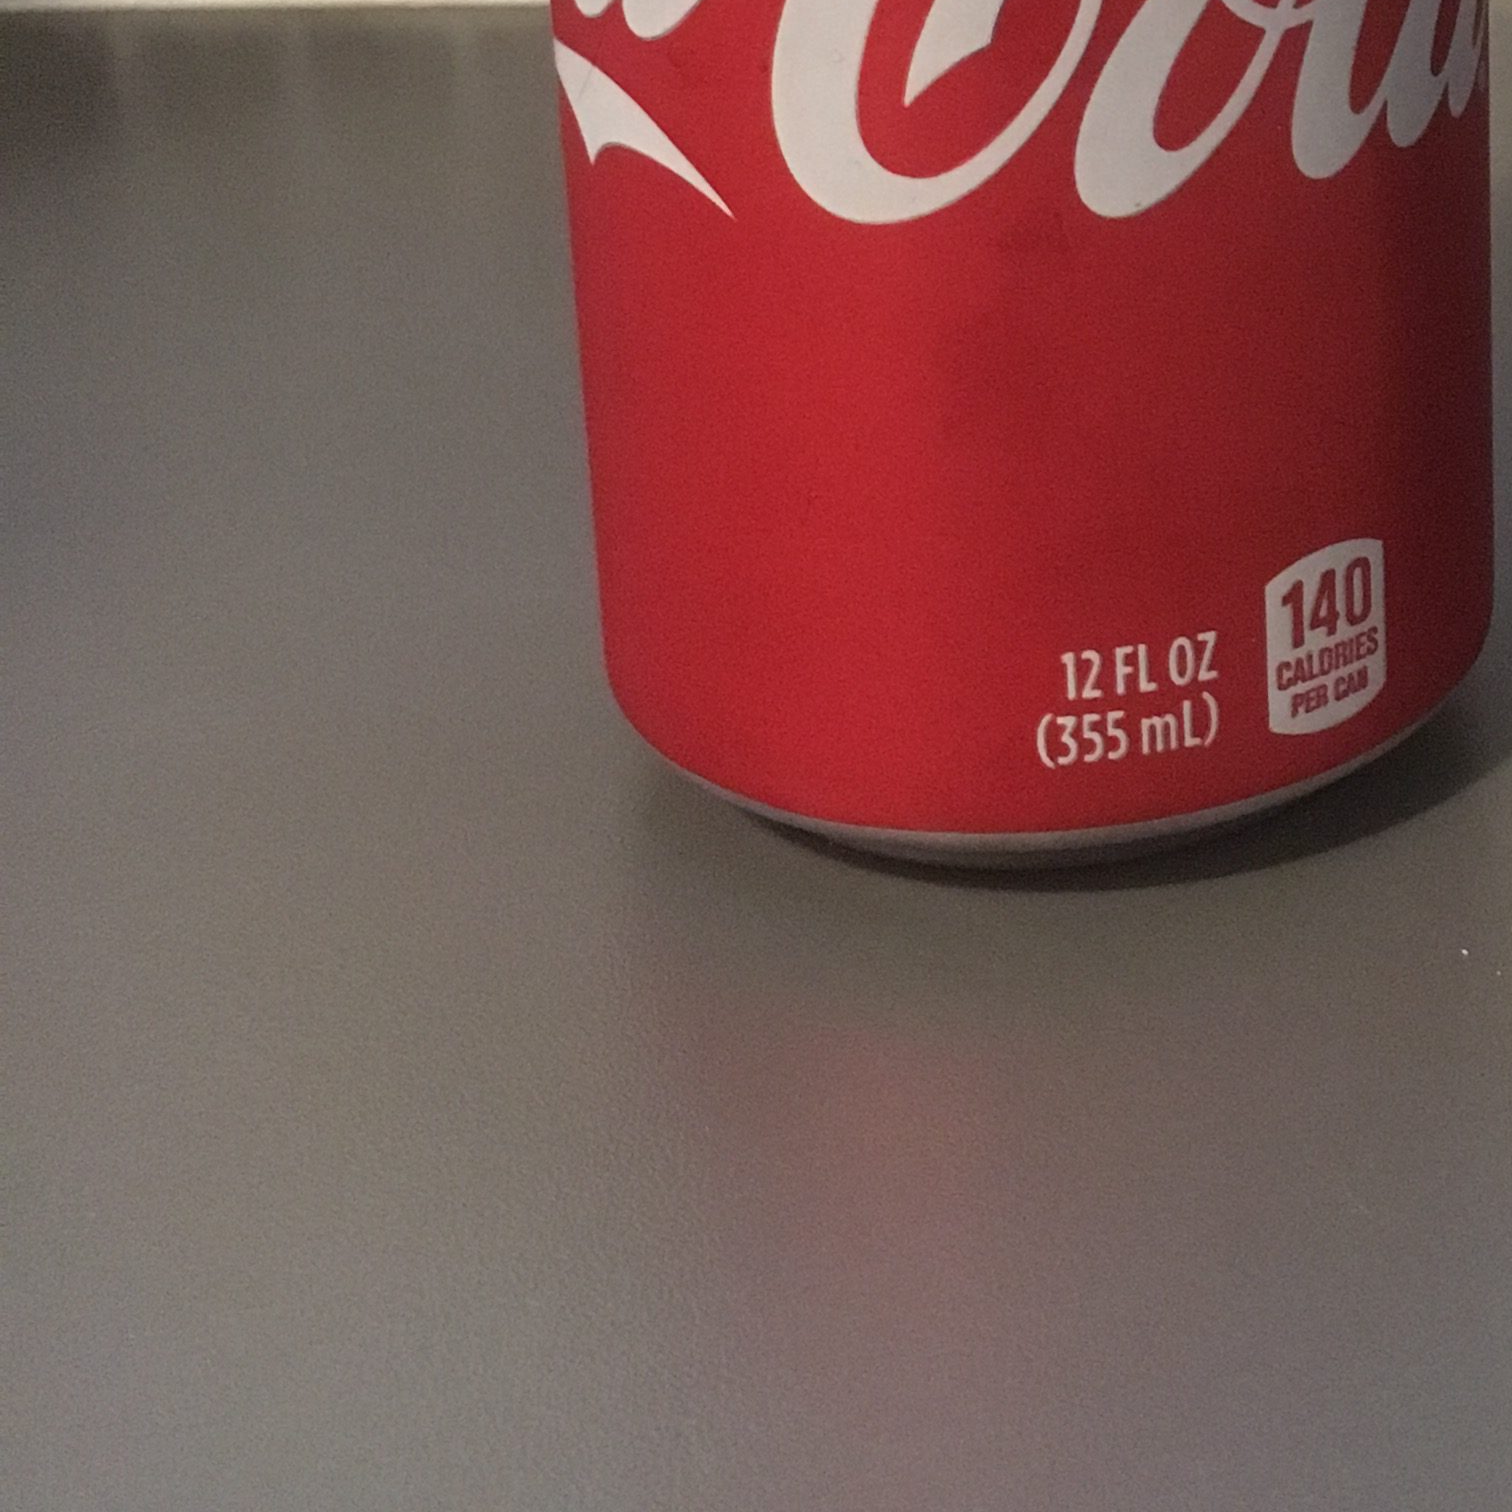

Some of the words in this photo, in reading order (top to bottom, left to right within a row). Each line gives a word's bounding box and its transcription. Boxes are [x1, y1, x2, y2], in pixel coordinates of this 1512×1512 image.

[1280, 556, 1373, 650] 140
[1060, 649, 1103, 701] 12
[1113, 643, 1159, 696] FL
[1167, 629, 1220, 687] OZ
[1275, 625, 1380, 691] CALORIES
[1290, 682, 1330, 719] PER
[1333, 664, 1370, 702] CAN
[1035, 710, 1131, 770] (355
[1140, 690, 1220, 756] mL)
